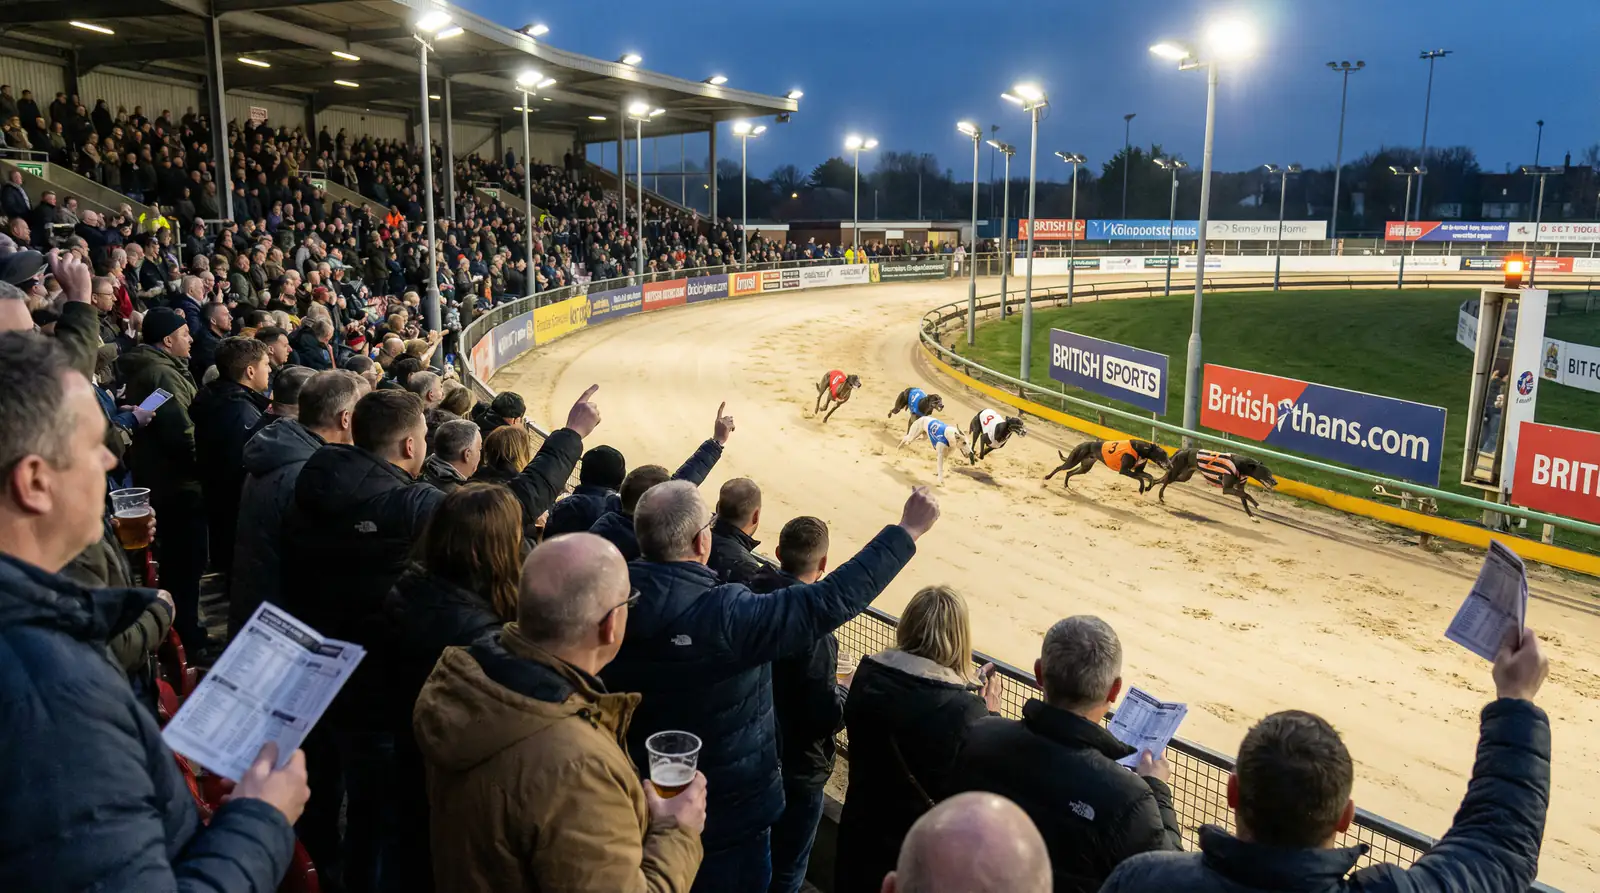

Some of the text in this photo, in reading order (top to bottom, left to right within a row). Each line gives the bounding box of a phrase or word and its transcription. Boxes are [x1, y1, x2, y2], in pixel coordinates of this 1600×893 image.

[1053, 343, 1157, 393] BRITISH SPORTS
[1568, 358, 1588, 376] BIT
[1208, 383, 1275, 425] British
[1108, 442, 1119, 454] 3
